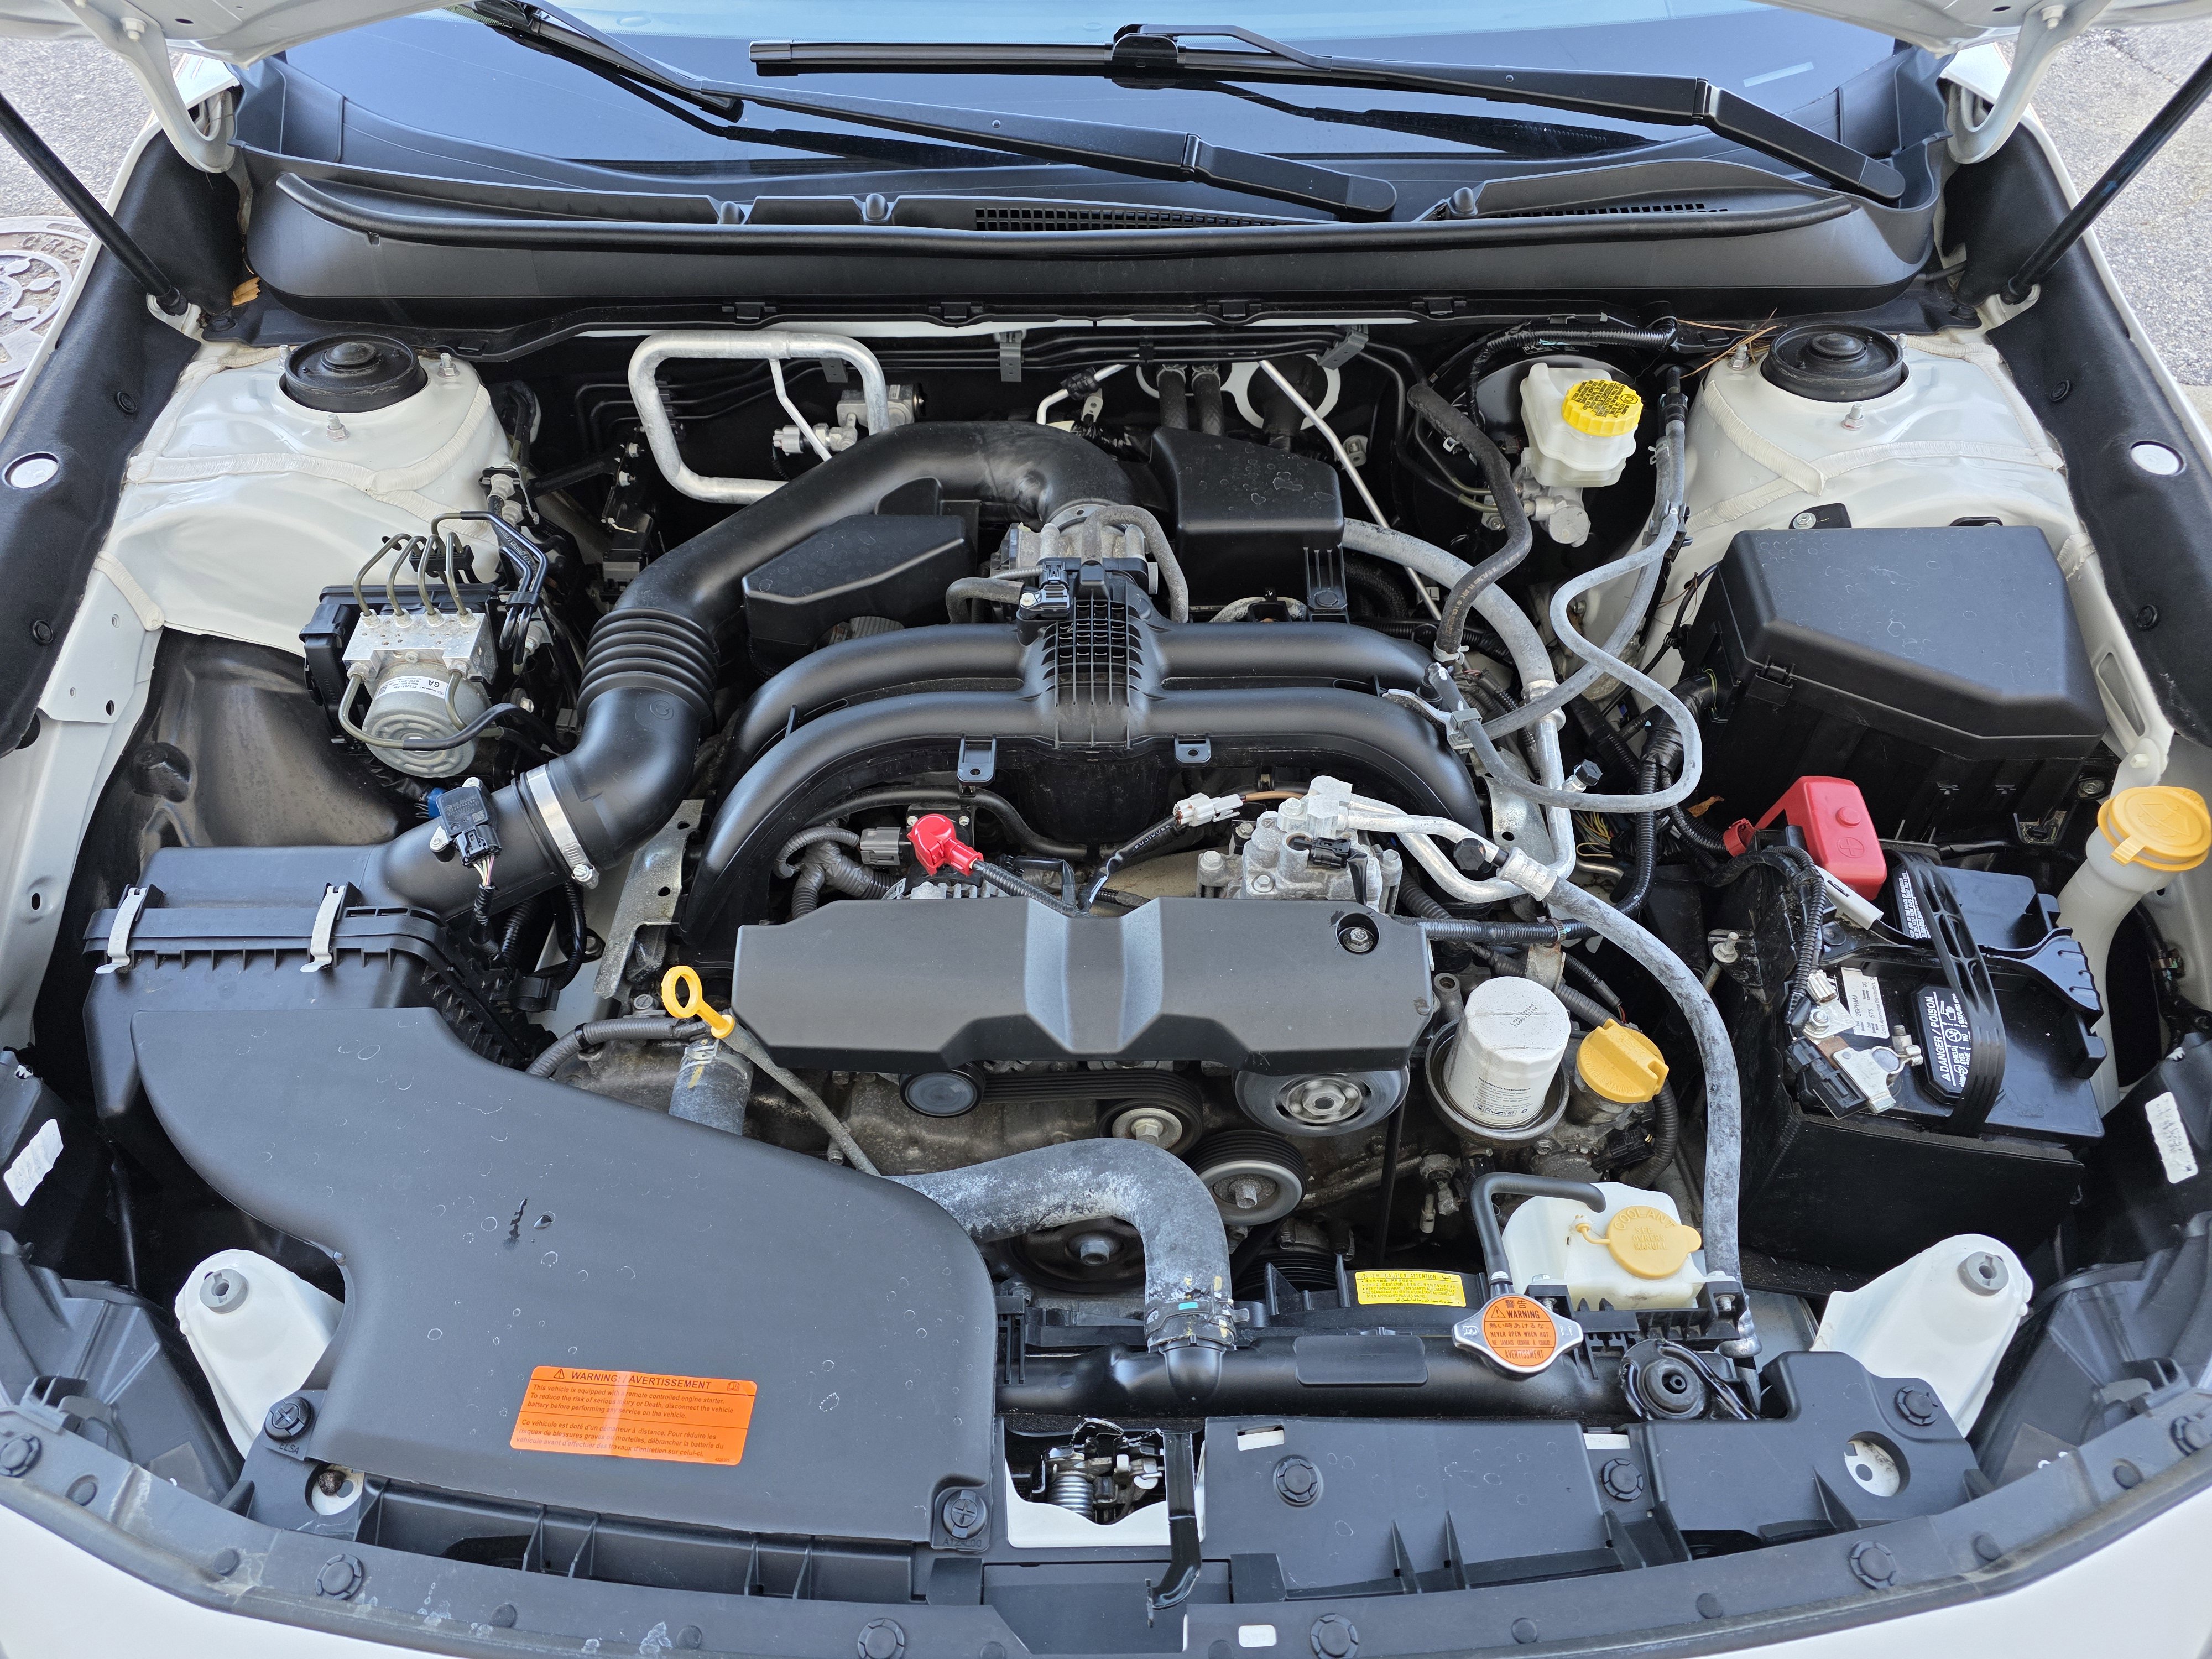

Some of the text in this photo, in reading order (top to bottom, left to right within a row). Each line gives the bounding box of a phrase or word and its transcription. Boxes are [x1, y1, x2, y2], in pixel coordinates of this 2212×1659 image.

[1135, 825, 1170, 849] FUJIKURA
[1851, 995, 1861, 1016] 26PRMJ
[1925, 997, 1939, 1027] POISON
[1933, 1036, 1949, 1072] DANGER
[1479, 1077, 1503, 1089] Installation
[1614, 1207, 1676, 1230] COOLANT
[1634, 1242, 1668, 1250] MANUAL
[1505, 1300, 1526, 1308] 警告
[1506, 1310, 1540, 1318] WARNING
[1505, 1350, 1544, 1358] AVERTISSMENT
[629, 1375, 711, 1389] AVERTISSEMENT
[618, 1398, 635, 1406] injury
[571, 1405, 605, 1413] performing
[638, 1428, 666, 1436] distance.
[615, 1436, 646, 1444] mortelles,
[648, 1438, 682, 1447] débrancher
[562, 1439, 595, 1448] d'effectuer
[634, 1445, 666, 1453] d'entretien
[680, 1449, 704, 1457] celui-ci.
